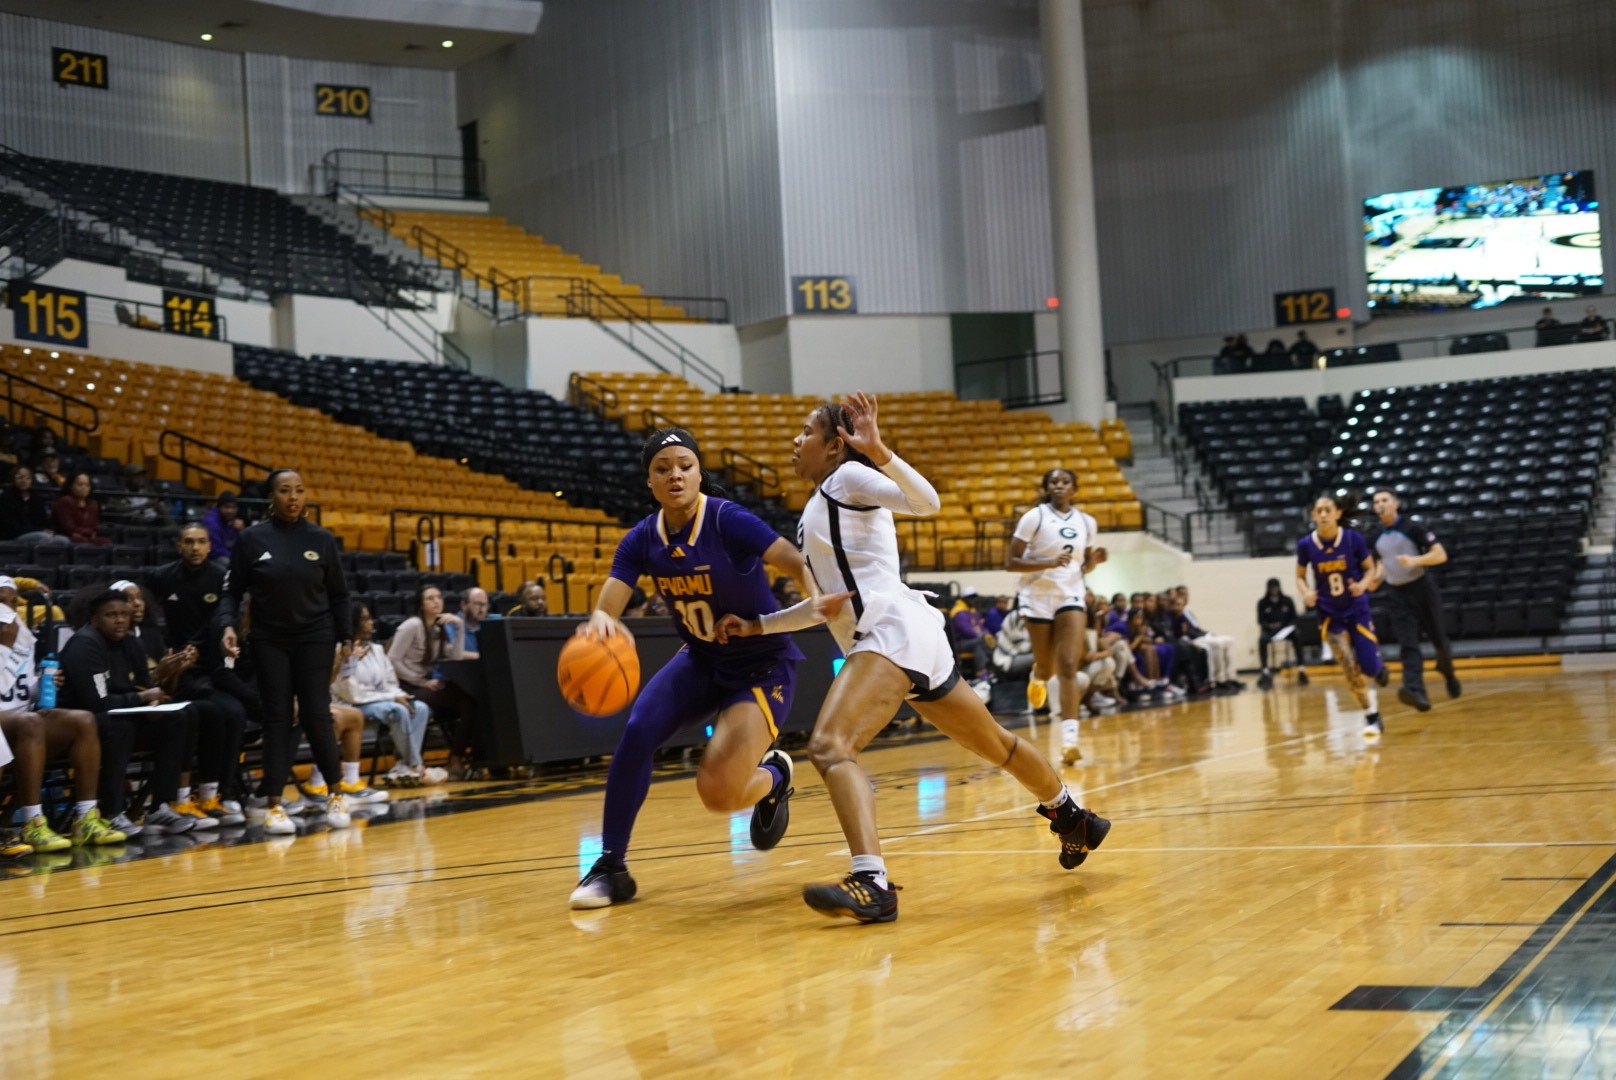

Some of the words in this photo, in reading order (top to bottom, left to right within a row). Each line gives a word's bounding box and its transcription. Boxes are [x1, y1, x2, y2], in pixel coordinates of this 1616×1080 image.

[59, 52, 103, 85] 211
[317, 86, 369, 116] 210
[798, 279, 852, 310] 113
[1280, 292, 1331, 322] 112
[20, 290, 81, 340] 115
[166, 296, 213, 336] 114
[1059, 527, 1077, 539] G
[657, 573, 714, 597] PVAMU
[1328, 572, 1345, 597] 8
[674, 600, 715, 642] 10
